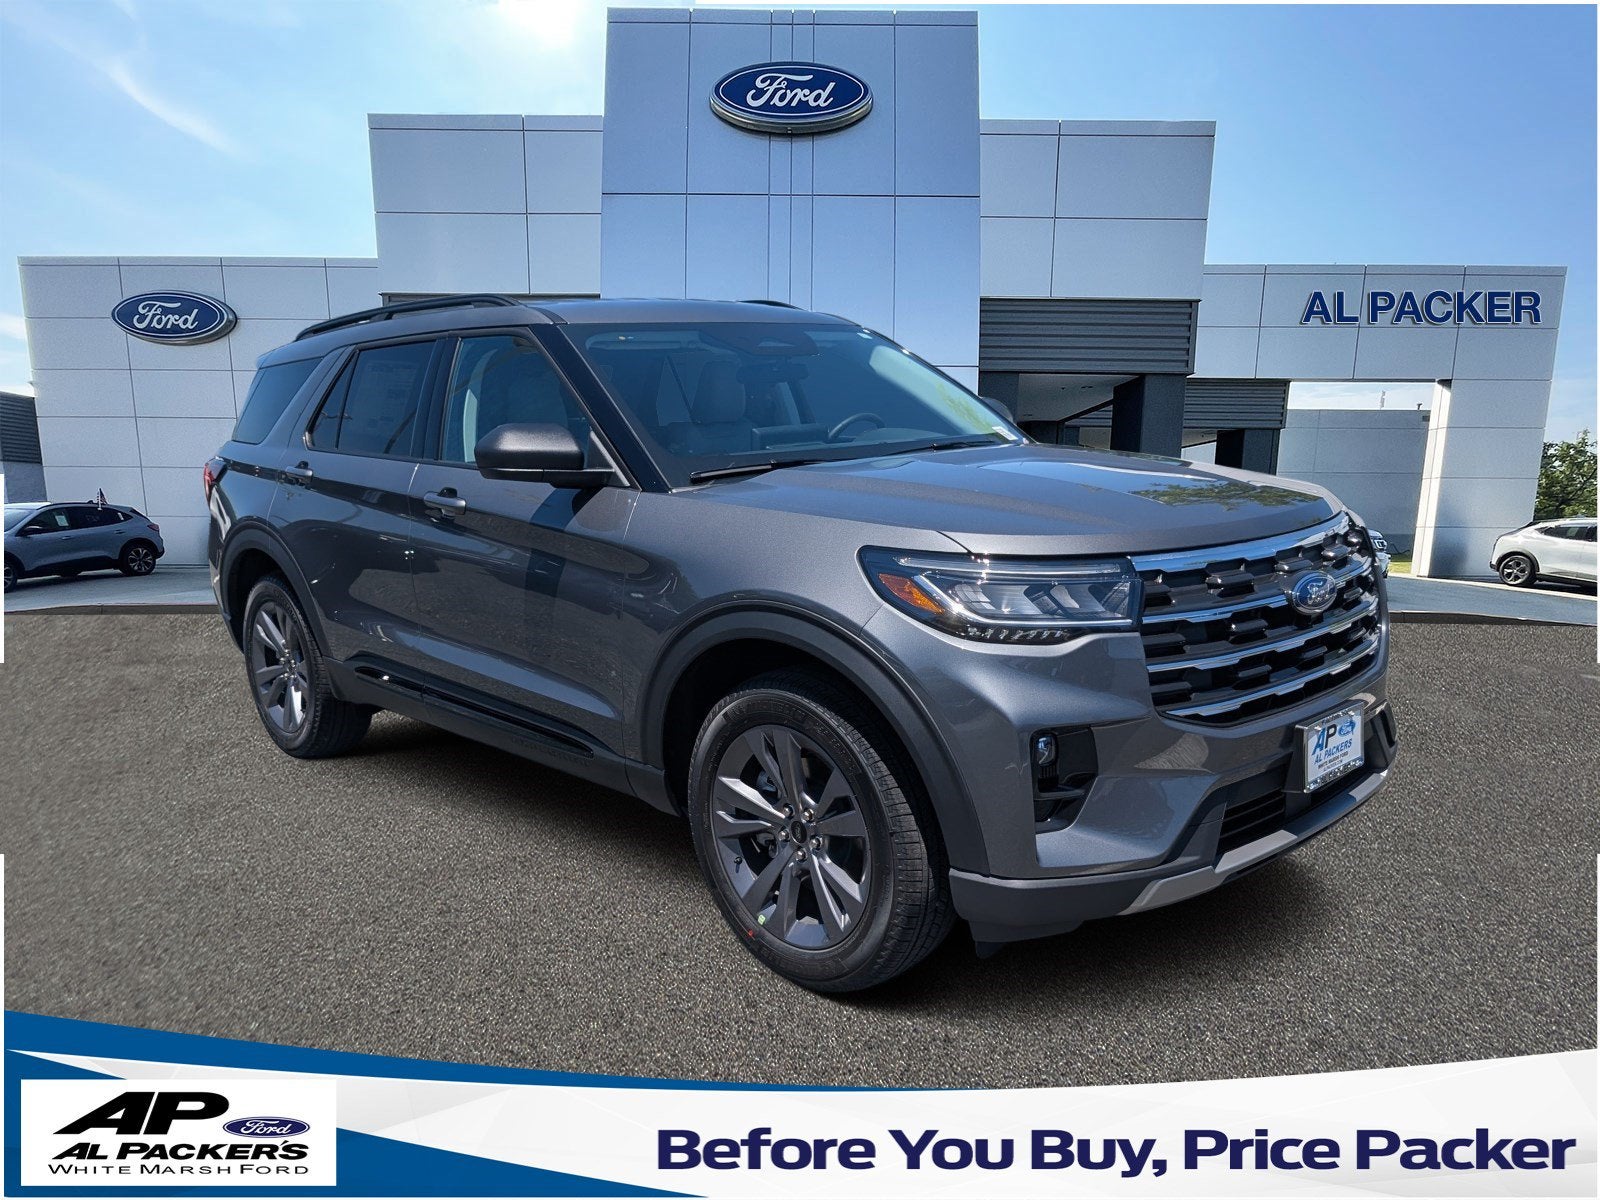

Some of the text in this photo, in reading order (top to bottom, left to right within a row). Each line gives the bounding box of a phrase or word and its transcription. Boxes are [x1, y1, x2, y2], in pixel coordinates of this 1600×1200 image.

[747, 73, 836, 107] Ford
[133, 301, 198, 329] Ford
[1302, 290, 1542, 324] AL PACKER
[1312, 723, 1337, 755] AP
[1324, 738, 1353, 761] PACKERS
